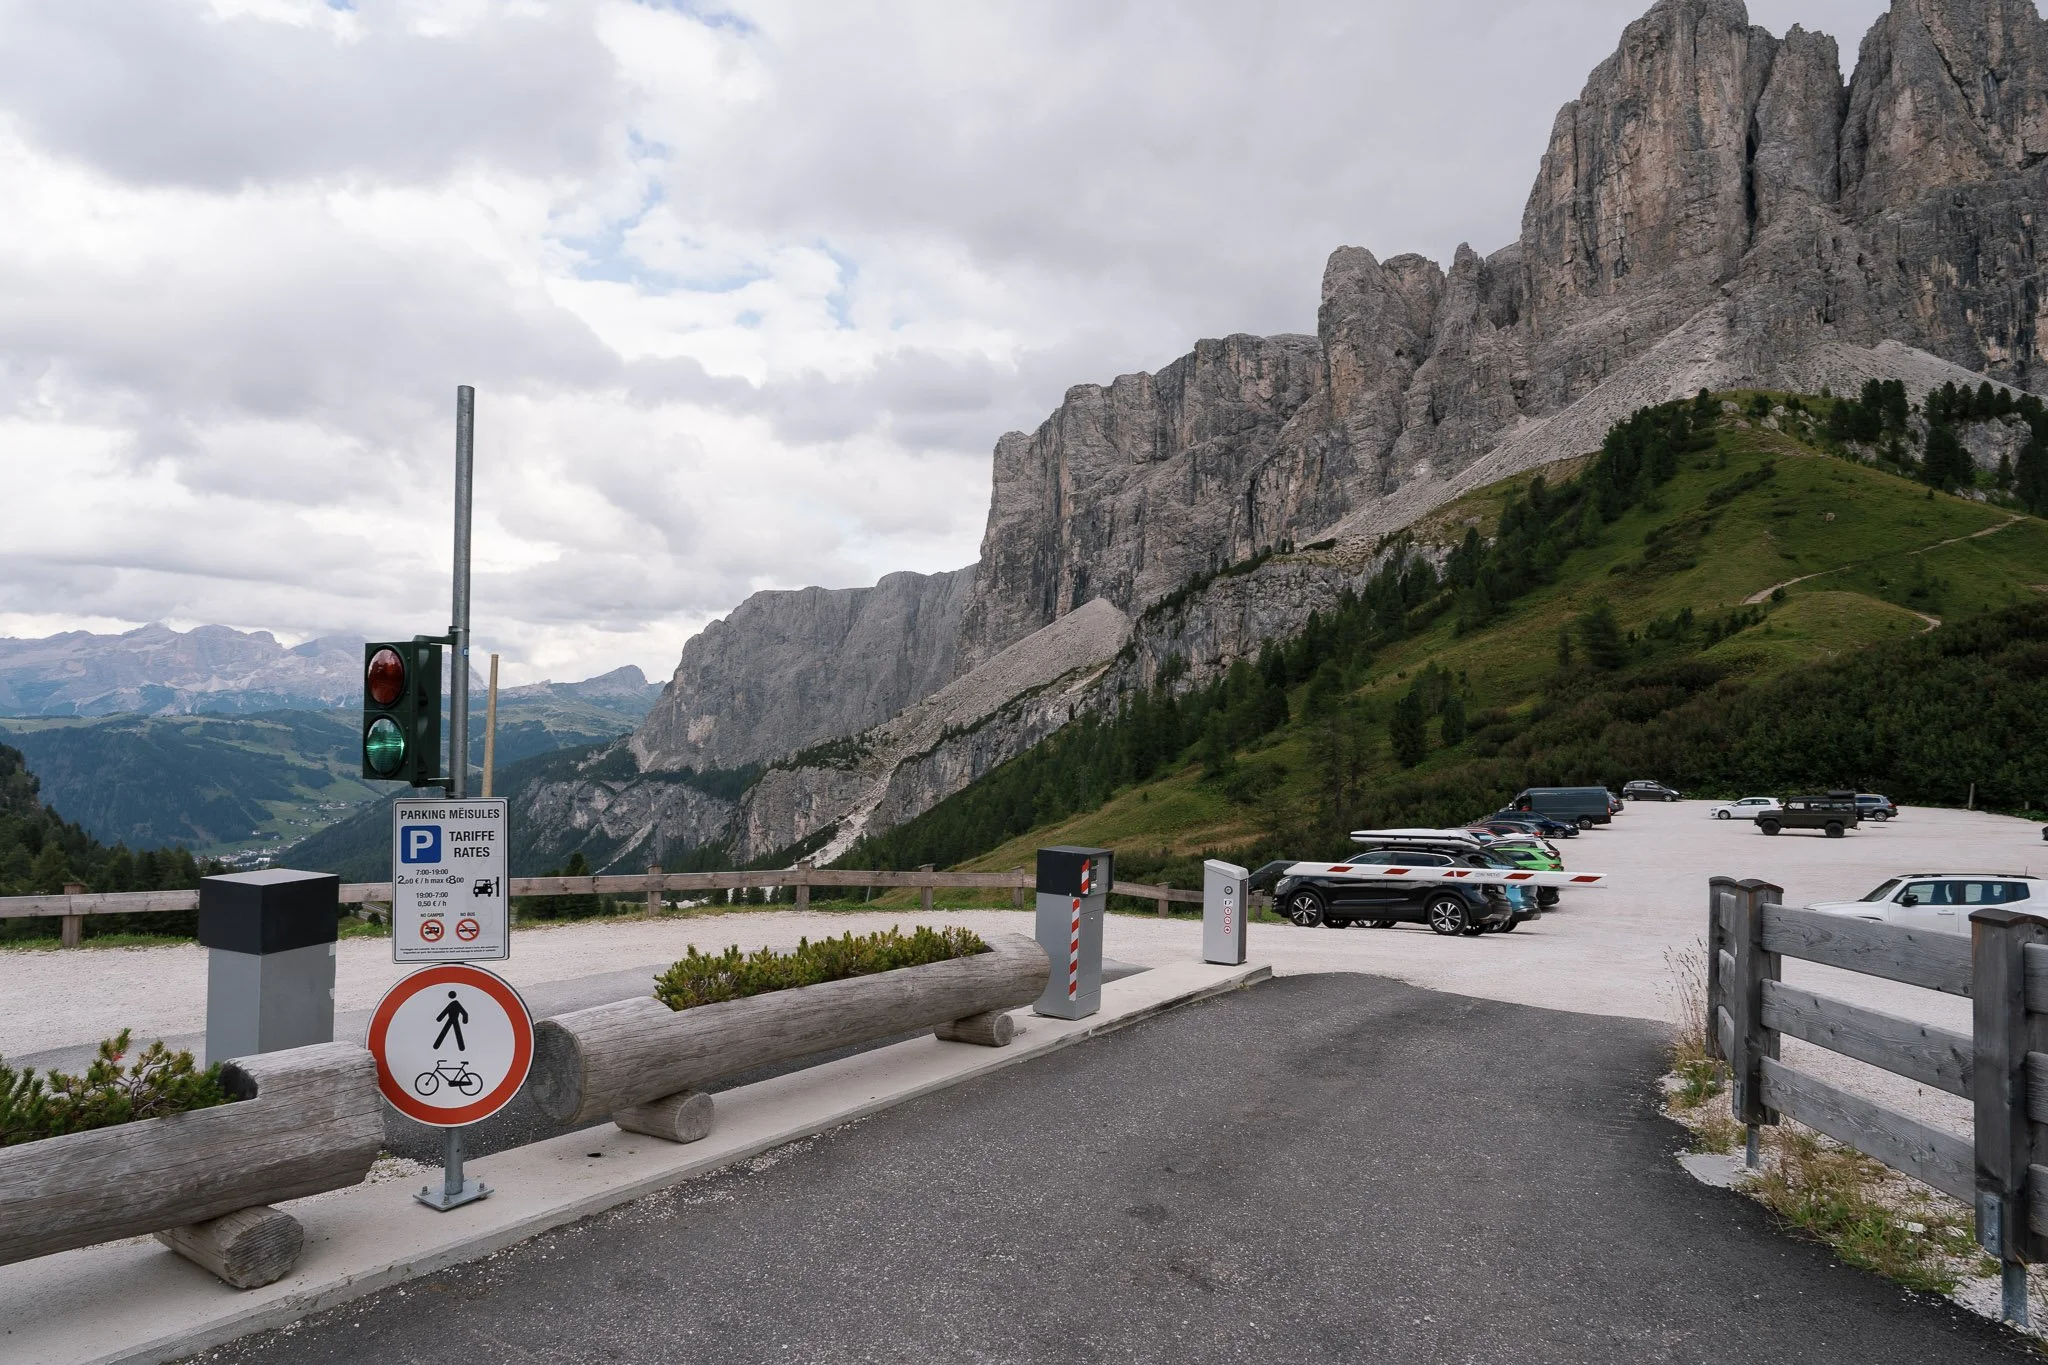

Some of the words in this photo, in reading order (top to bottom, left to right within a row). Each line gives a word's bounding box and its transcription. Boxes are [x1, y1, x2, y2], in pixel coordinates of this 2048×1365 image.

[400, 809, 446, 820] PARKING
[449, 807, 500, 819] MËISULES
[448, 830, 495, 842] TARIFFE
[410, 830, 434, 859] P
[453, 846, 490, 858] RATES
[415, 868, 449, 876] 7:00-19:00
[416, 891, 449, 899] 19:00-7:00
[417, 900, 431, 908] 0,50
